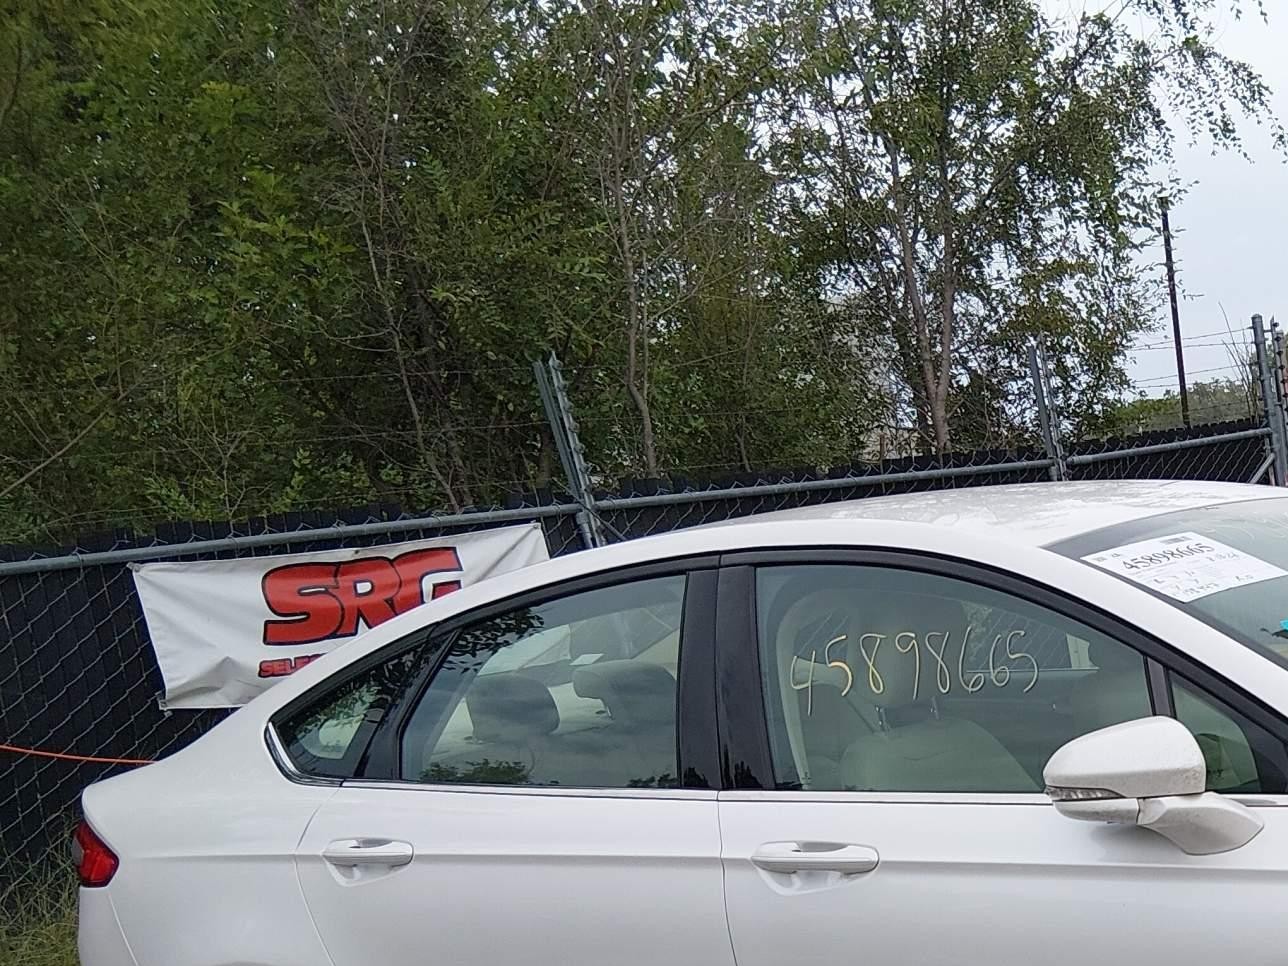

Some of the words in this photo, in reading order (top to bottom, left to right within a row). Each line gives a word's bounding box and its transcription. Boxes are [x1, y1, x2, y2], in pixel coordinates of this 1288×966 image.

[262, 547, 463, 646] SRG
[1122, 542, 1216, 571] 45898665
[790, 626, 1039, 717] 45898665
